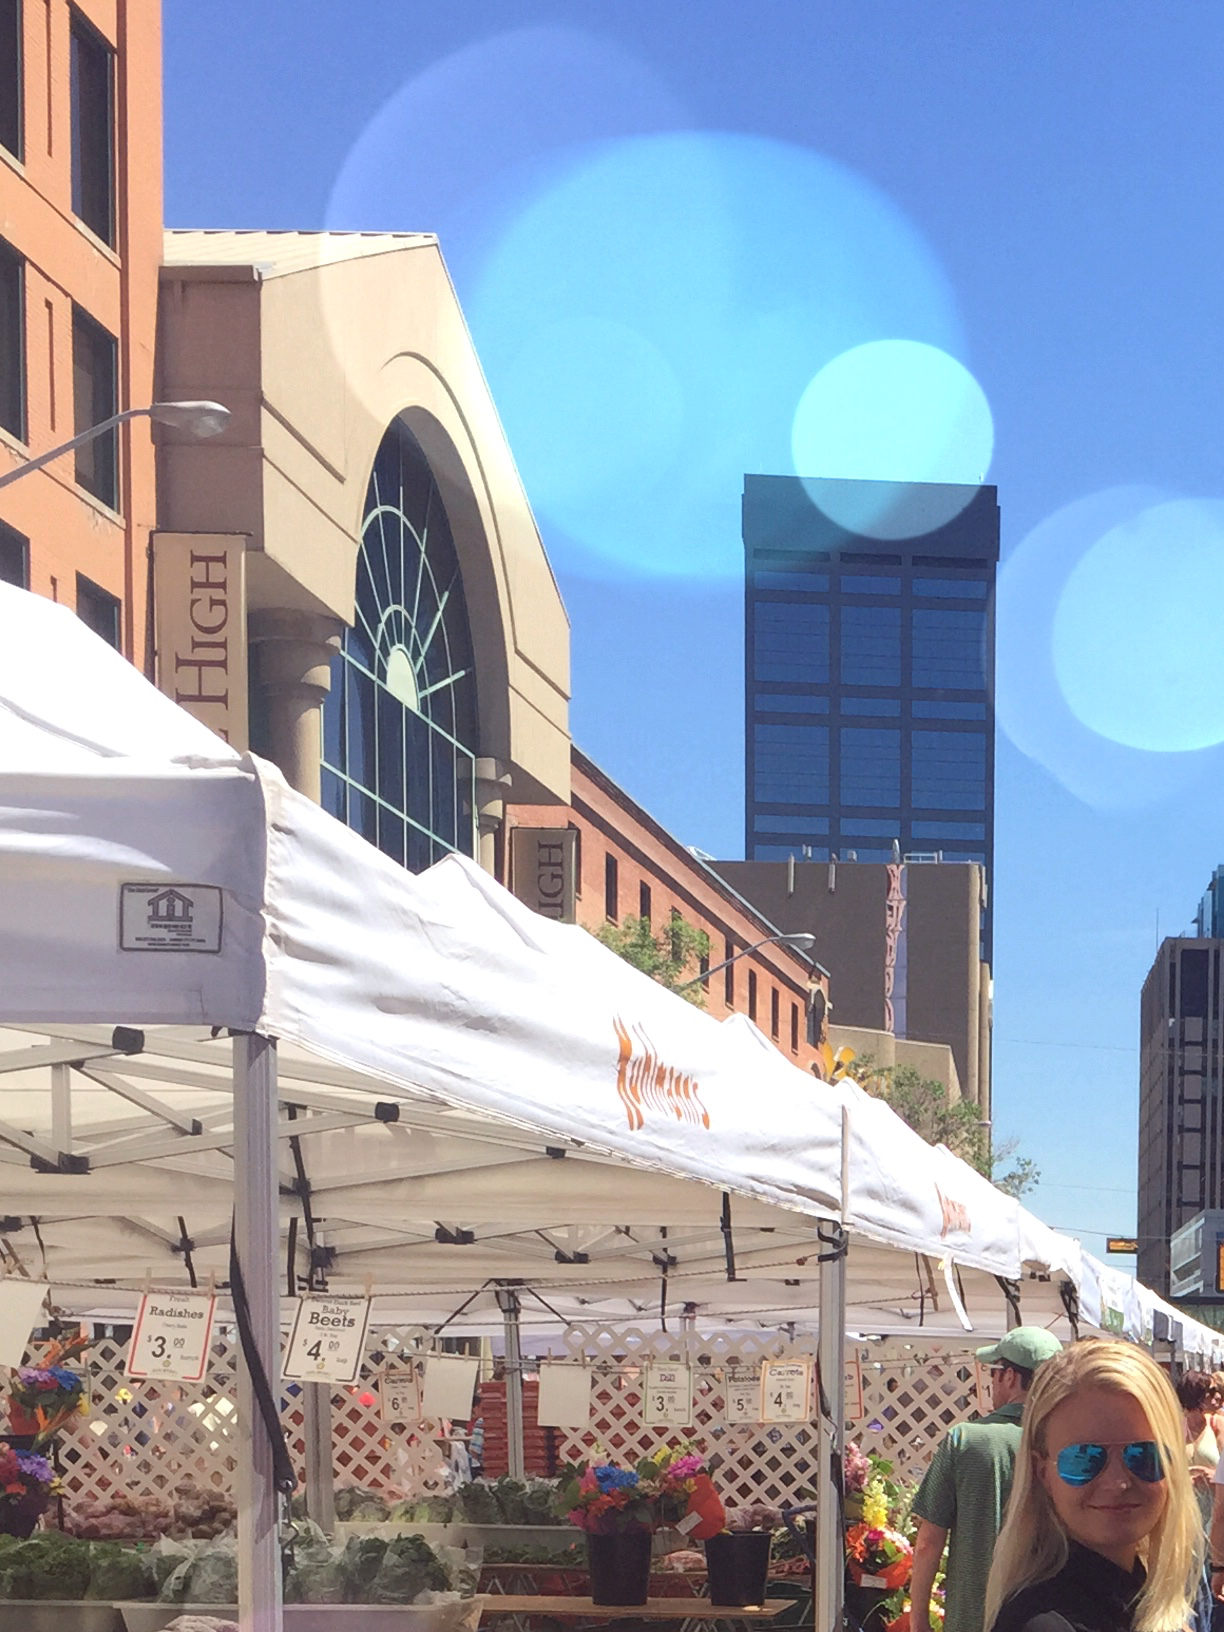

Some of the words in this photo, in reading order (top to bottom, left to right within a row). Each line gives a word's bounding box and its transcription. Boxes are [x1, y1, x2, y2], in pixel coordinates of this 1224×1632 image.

[174, 549, 229, 711] HIGH
[537, 840, 565, 919] IGH
[149, 1306, 204, 1319] Radishes
[322, 1305, 349, 1316] Baby
[308, 1312, 355, 1327] Beets
